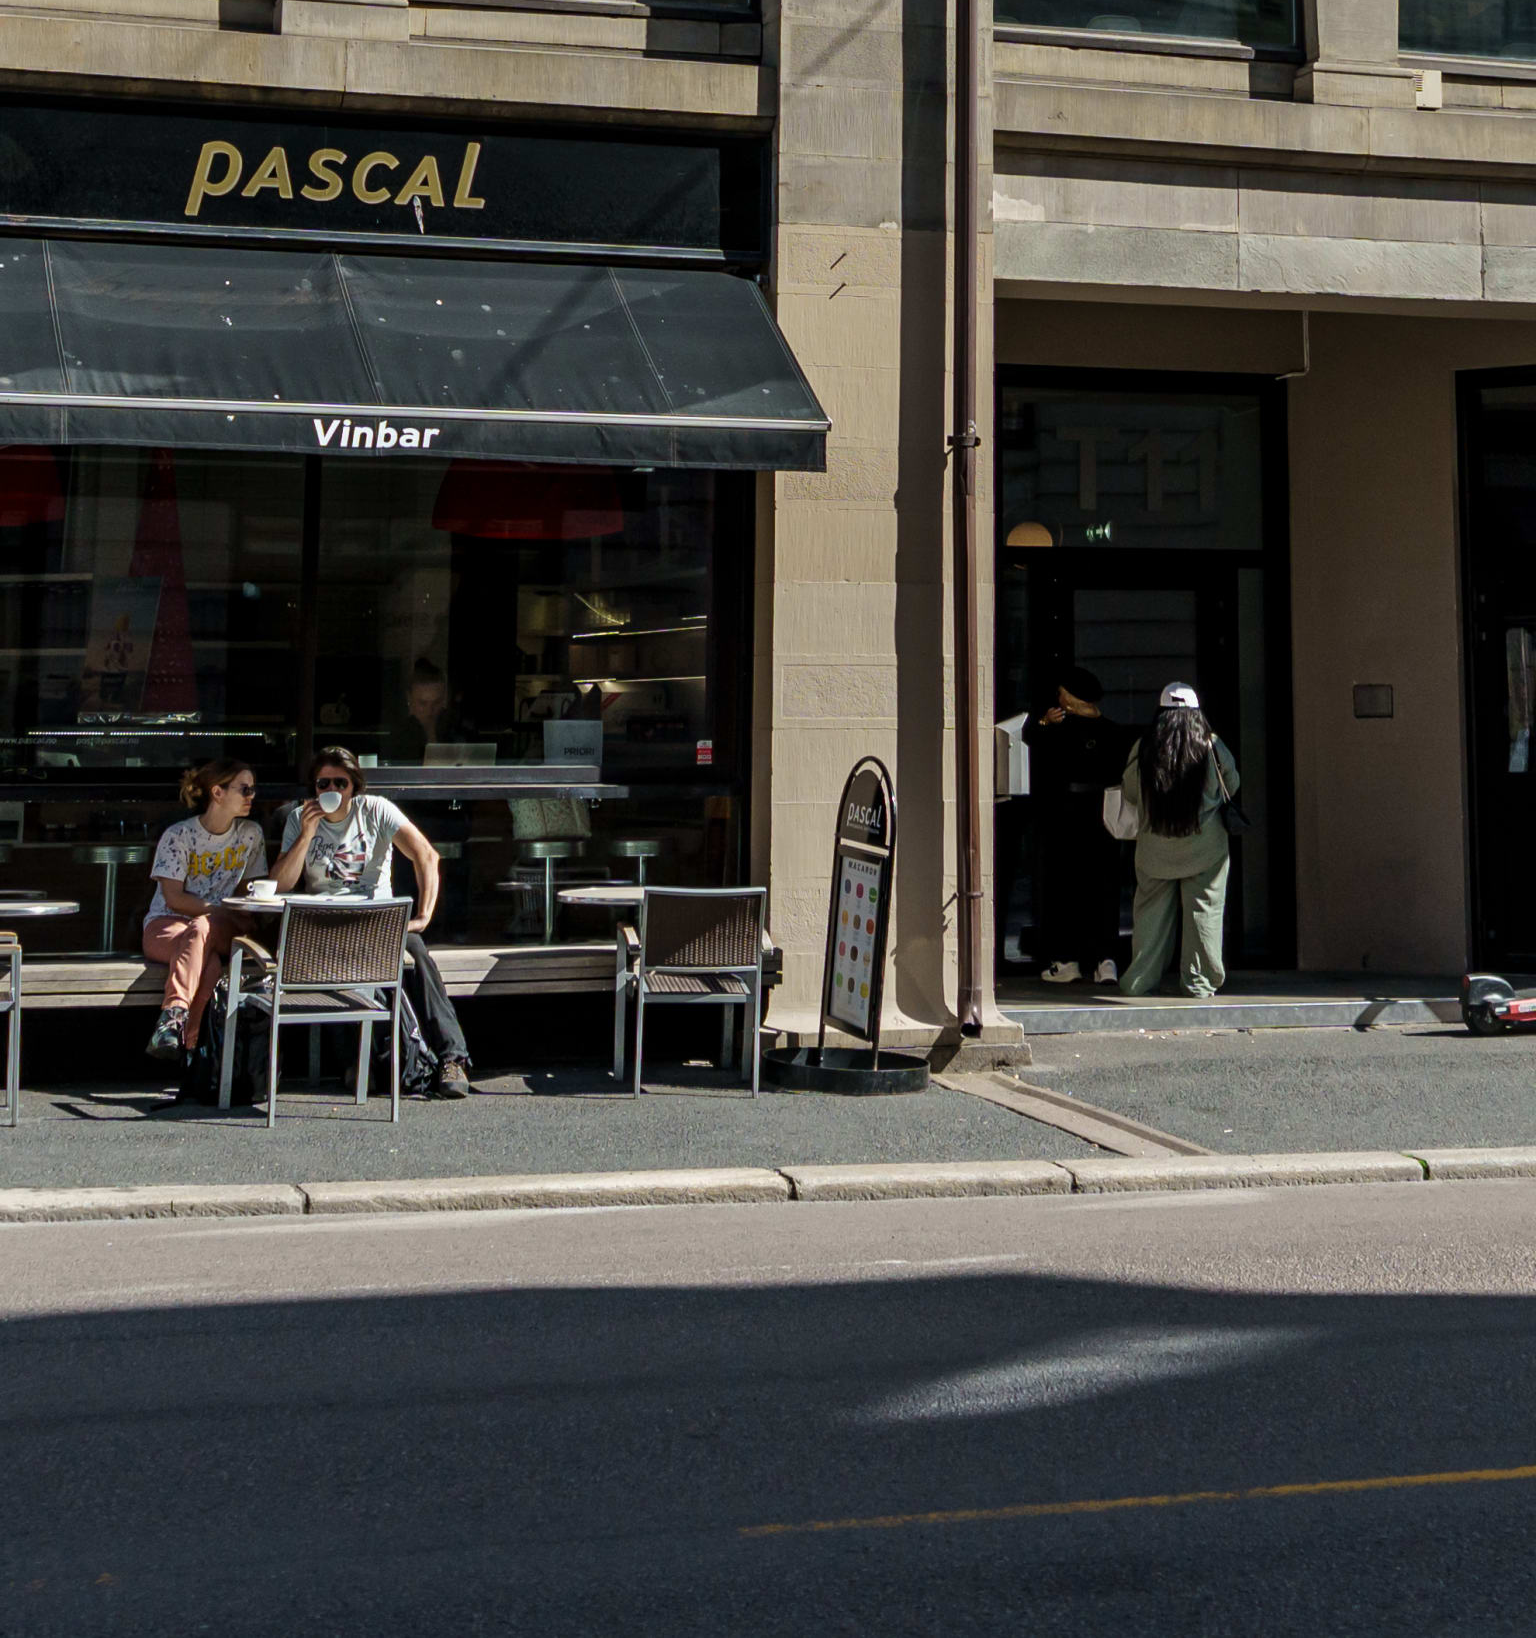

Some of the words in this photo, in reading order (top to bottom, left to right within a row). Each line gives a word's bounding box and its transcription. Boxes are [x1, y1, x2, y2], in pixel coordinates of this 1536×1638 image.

[183, 139, 487, 217] PASCAL
[313, 418, 440, 449] Vinbar
[563, 746, 595, 756] PRIORI
[846, 802, 883, 829] PASCAL
